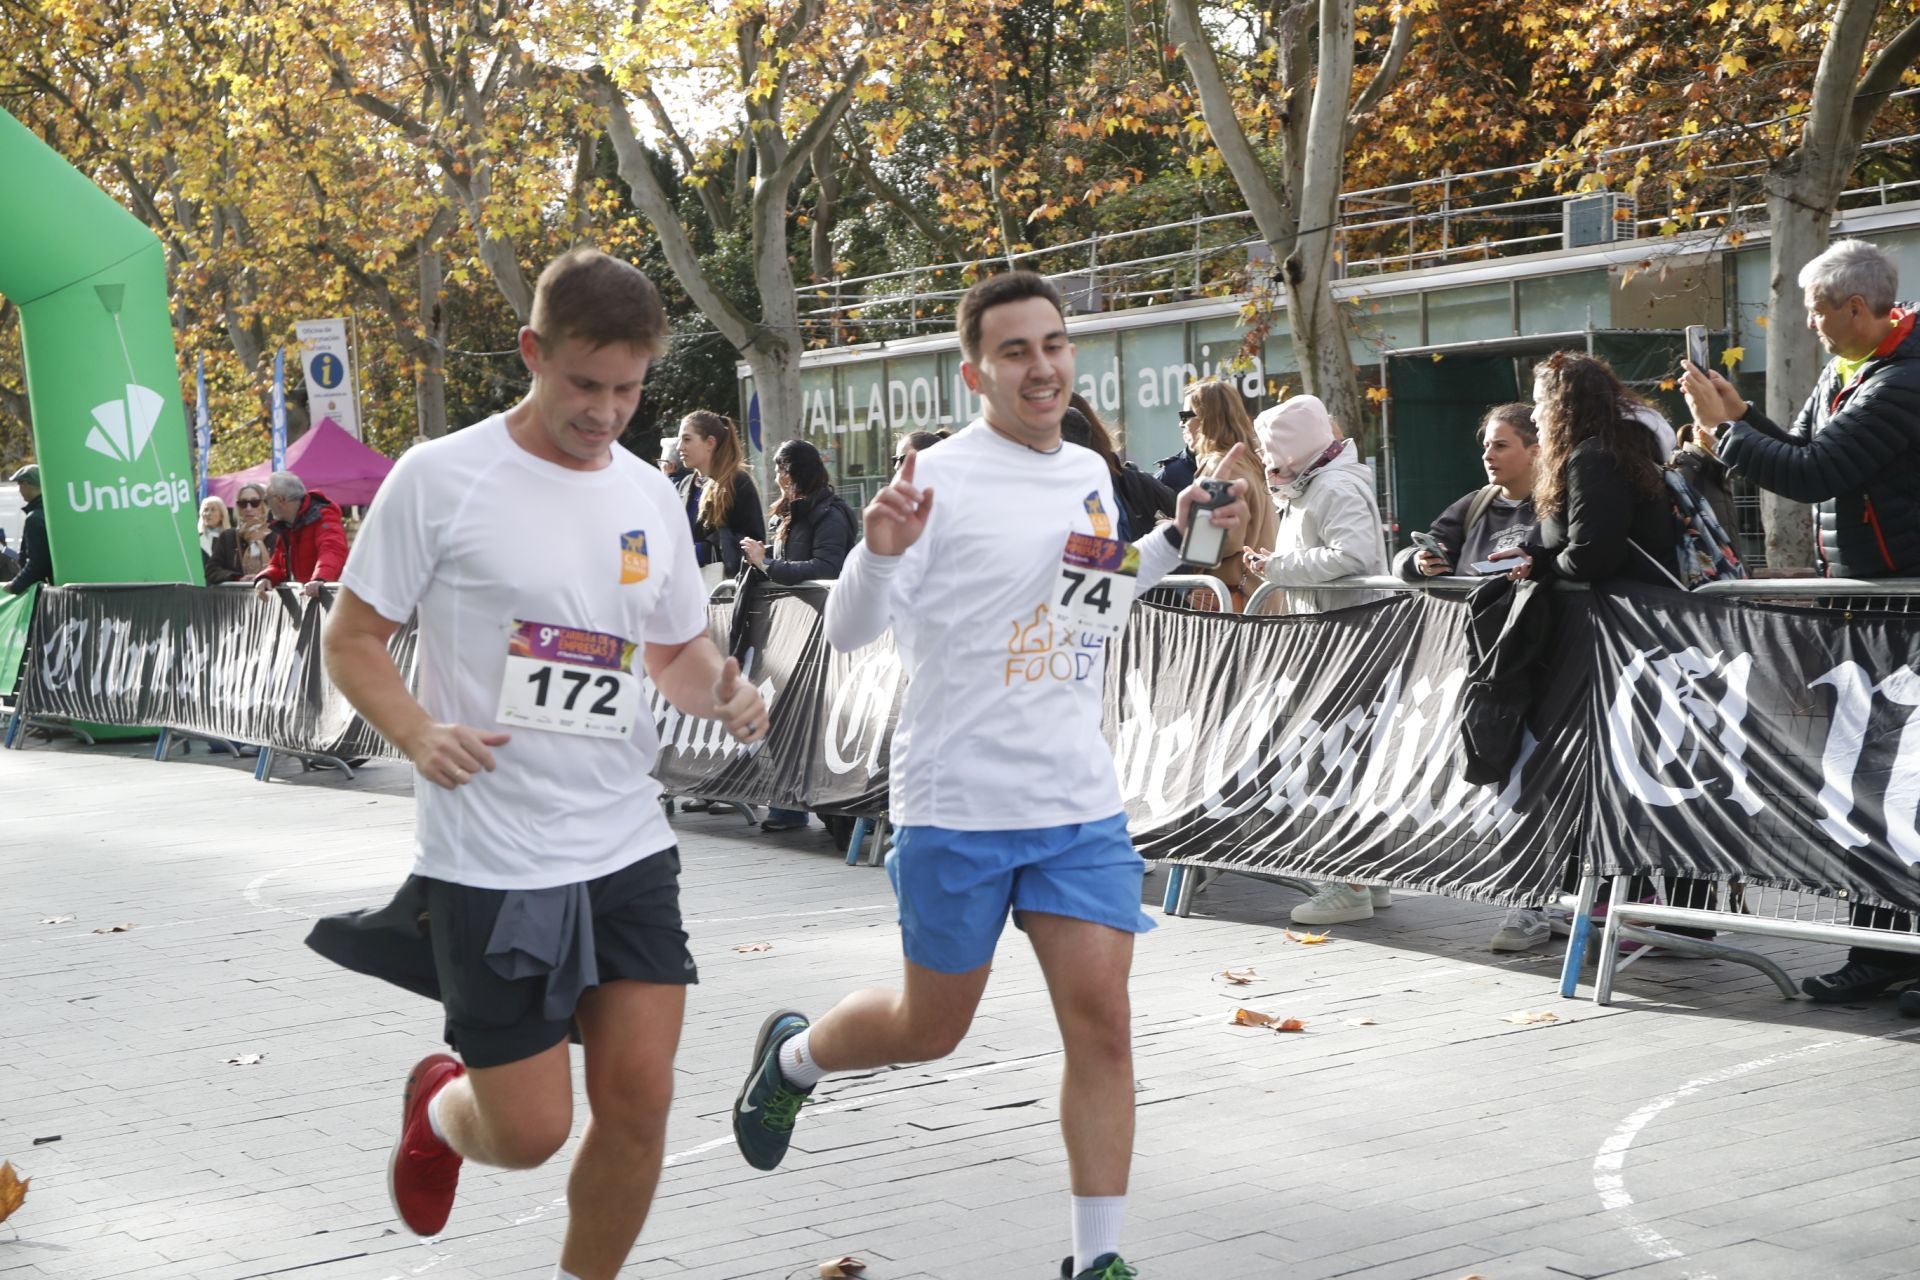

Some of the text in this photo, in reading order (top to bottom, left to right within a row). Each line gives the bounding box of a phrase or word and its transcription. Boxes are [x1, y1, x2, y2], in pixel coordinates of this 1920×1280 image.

[67, 472, 190, 513] Unicaja
[1060, 569, 1112, 614] 74
[528, 666, 620, 716] 172
